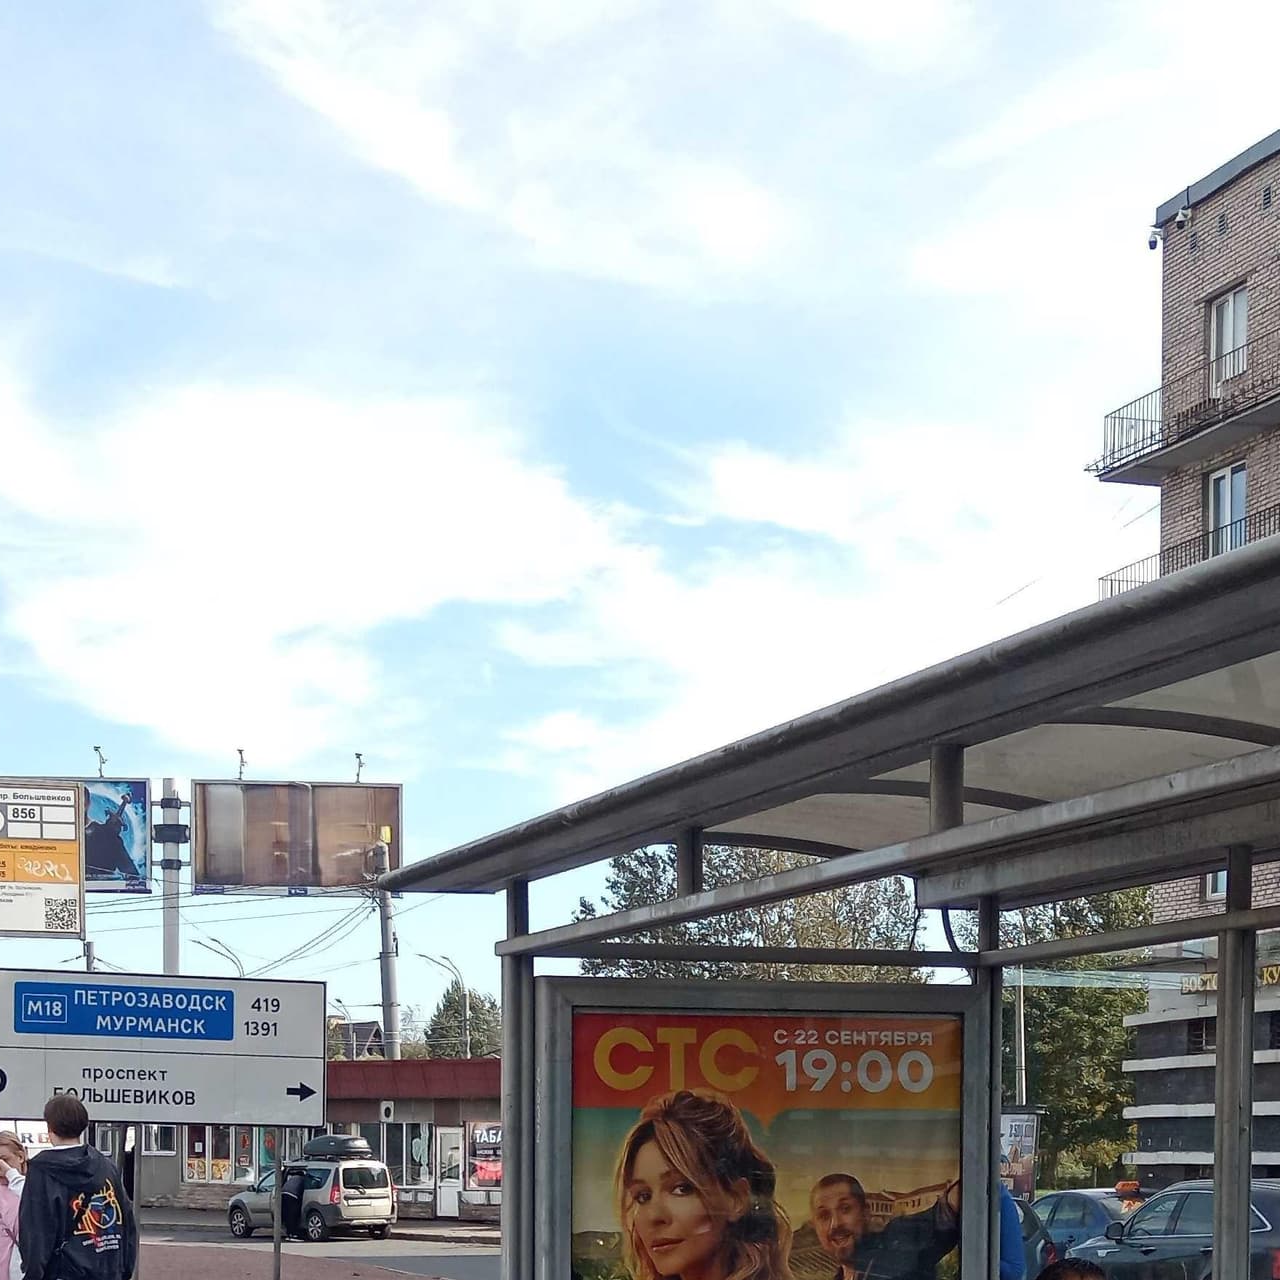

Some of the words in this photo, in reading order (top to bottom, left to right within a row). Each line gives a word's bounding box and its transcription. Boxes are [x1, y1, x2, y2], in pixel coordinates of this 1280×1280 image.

[12, 807, 36, 819] 856
[27, 999, 63, 1017] М18
[74, 989, 228, 1012] ПЕТРОЗАВОДСК
[250, 997, 280, 1013] 419
[96, 1015, 206, 1034] МУРМАНСК
[243, 1021, 279, 1037] 1391
[795, 1029, 821, 1045] 22
[825, 1030, 934, 1047] СЕНТЯБРЯ
[593, 1027, 761, 1092] СТС
[81, 1067, 168, 1083] проспект
[775, 1049, 935, 1094] 19:00
